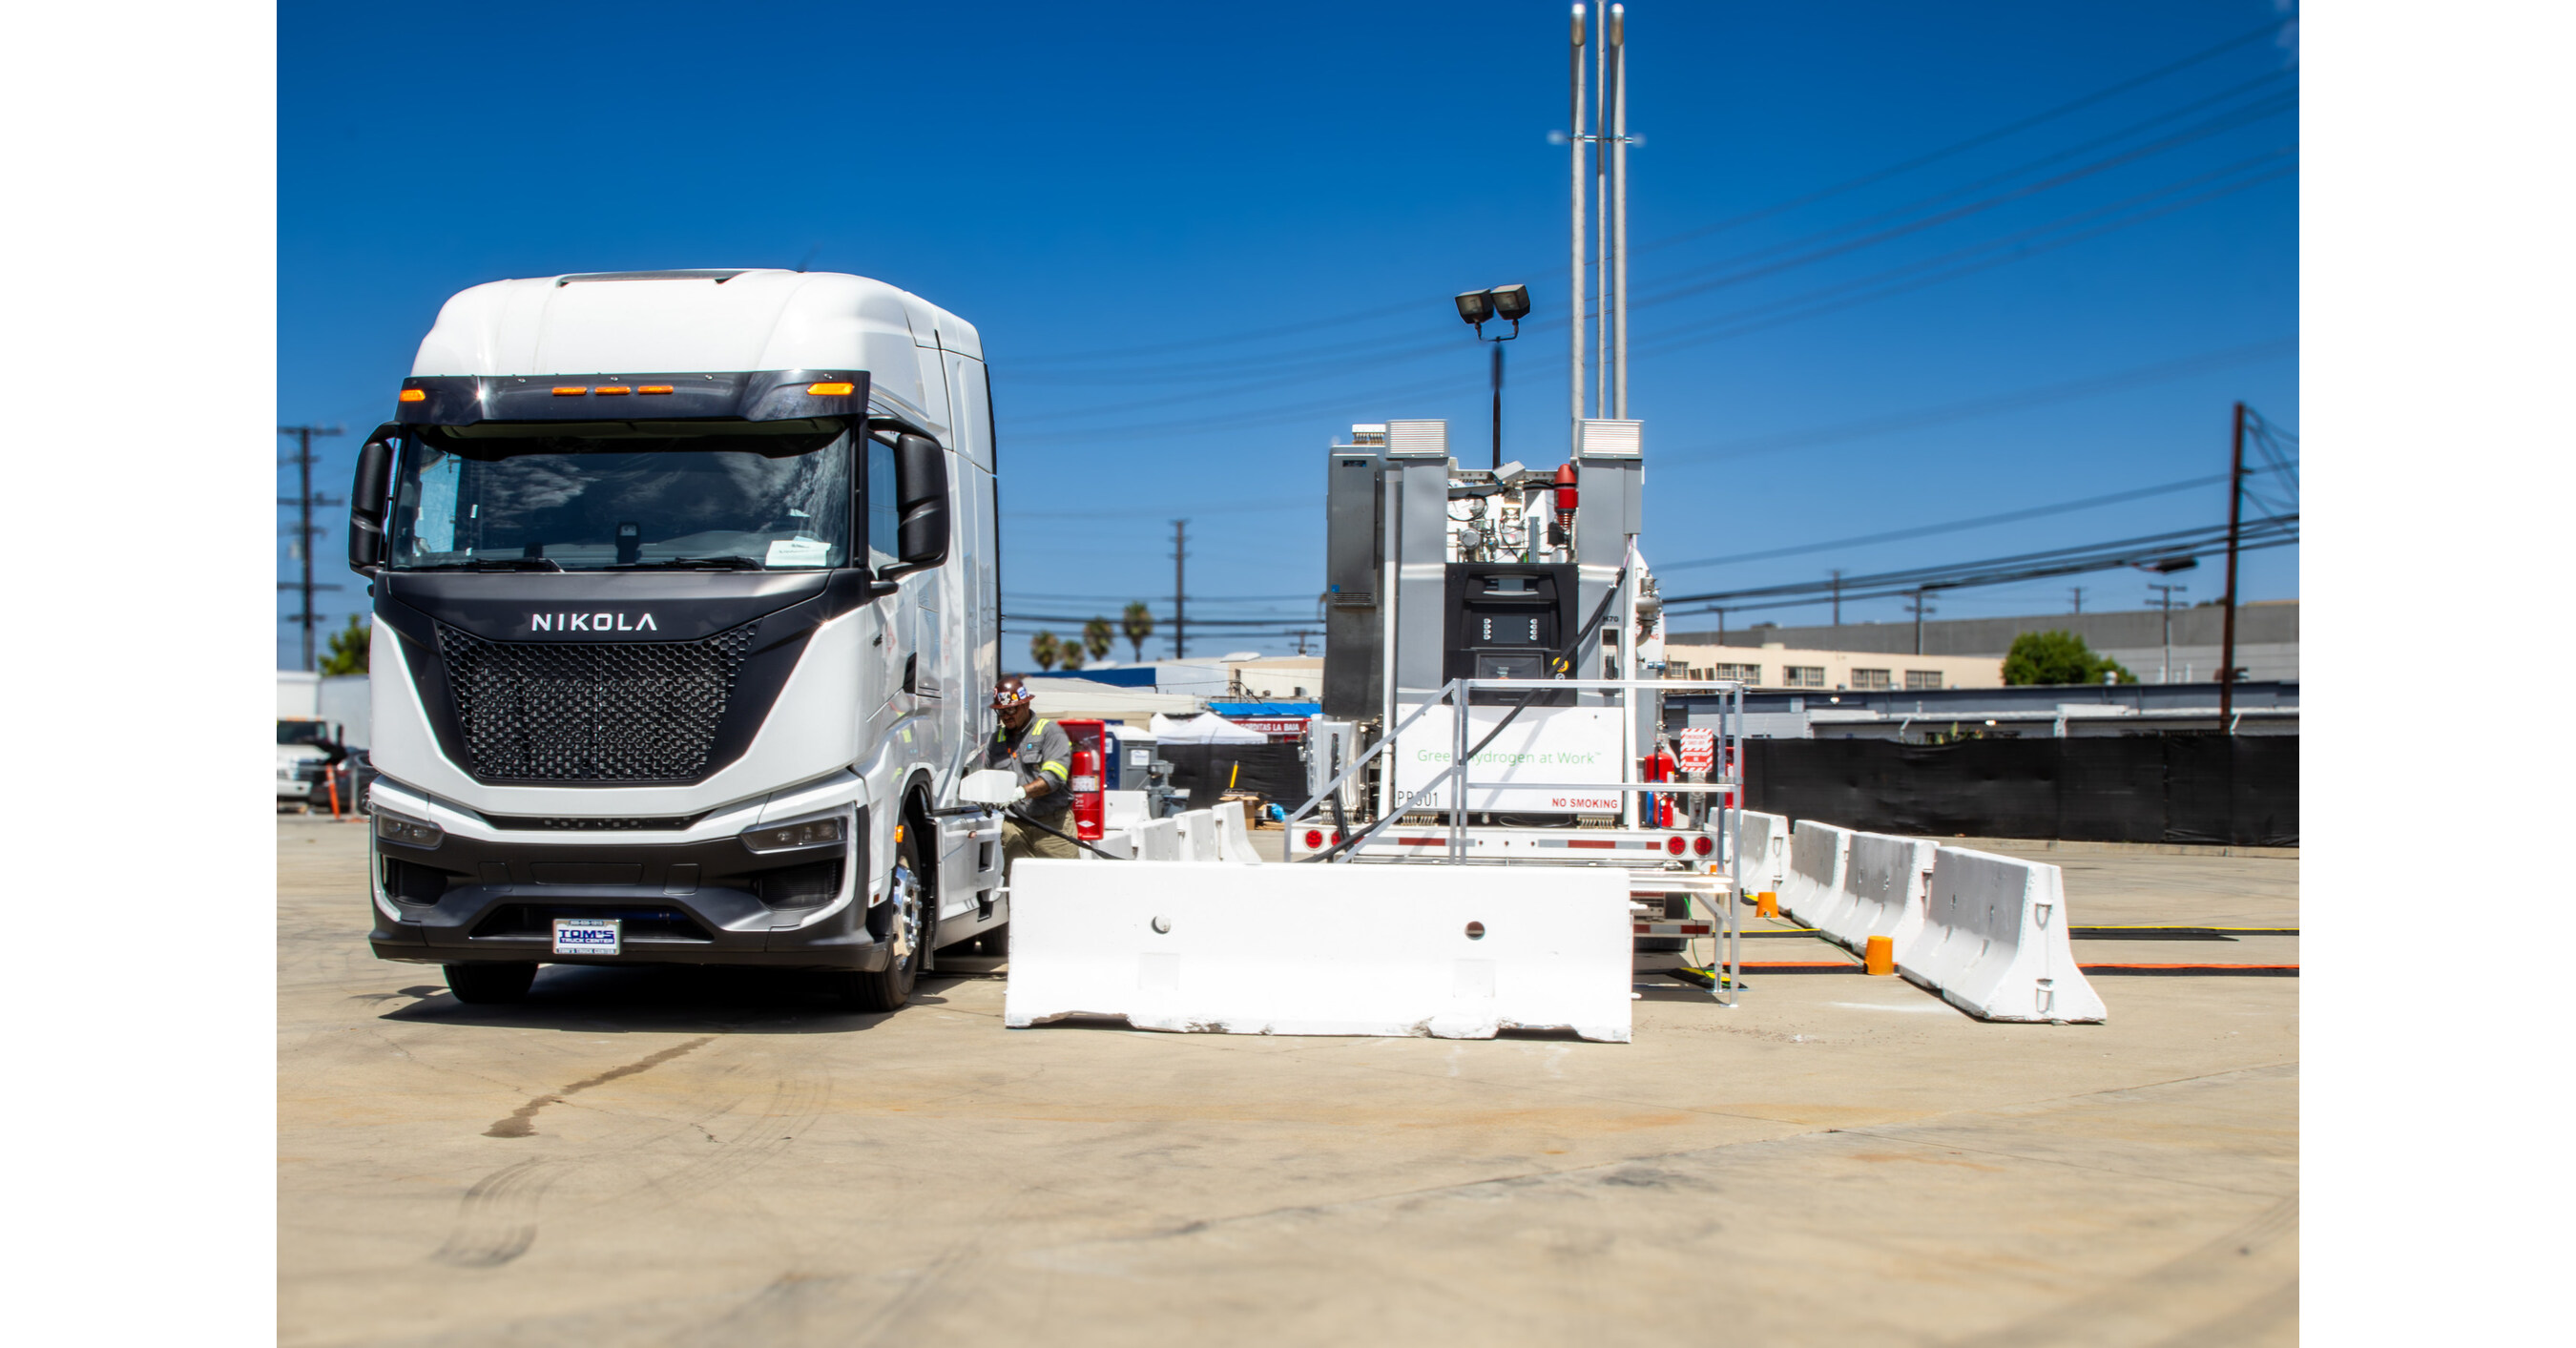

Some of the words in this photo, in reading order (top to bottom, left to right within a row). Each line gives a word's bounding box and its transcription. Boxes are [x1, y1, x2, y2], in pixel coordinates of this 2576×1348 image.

[531, 613, 657, 631] NIKOLA
[1418, 749, 1451, 762] Gree
[1472, 750, 1535, 767] ydrogen
[1539, 753, 1553, 764] at
[1551, 798, 1567, 808] NO
[1570, 798, 1618, 809] SMOKING
[558, 930, 614, 939] TOM'S
